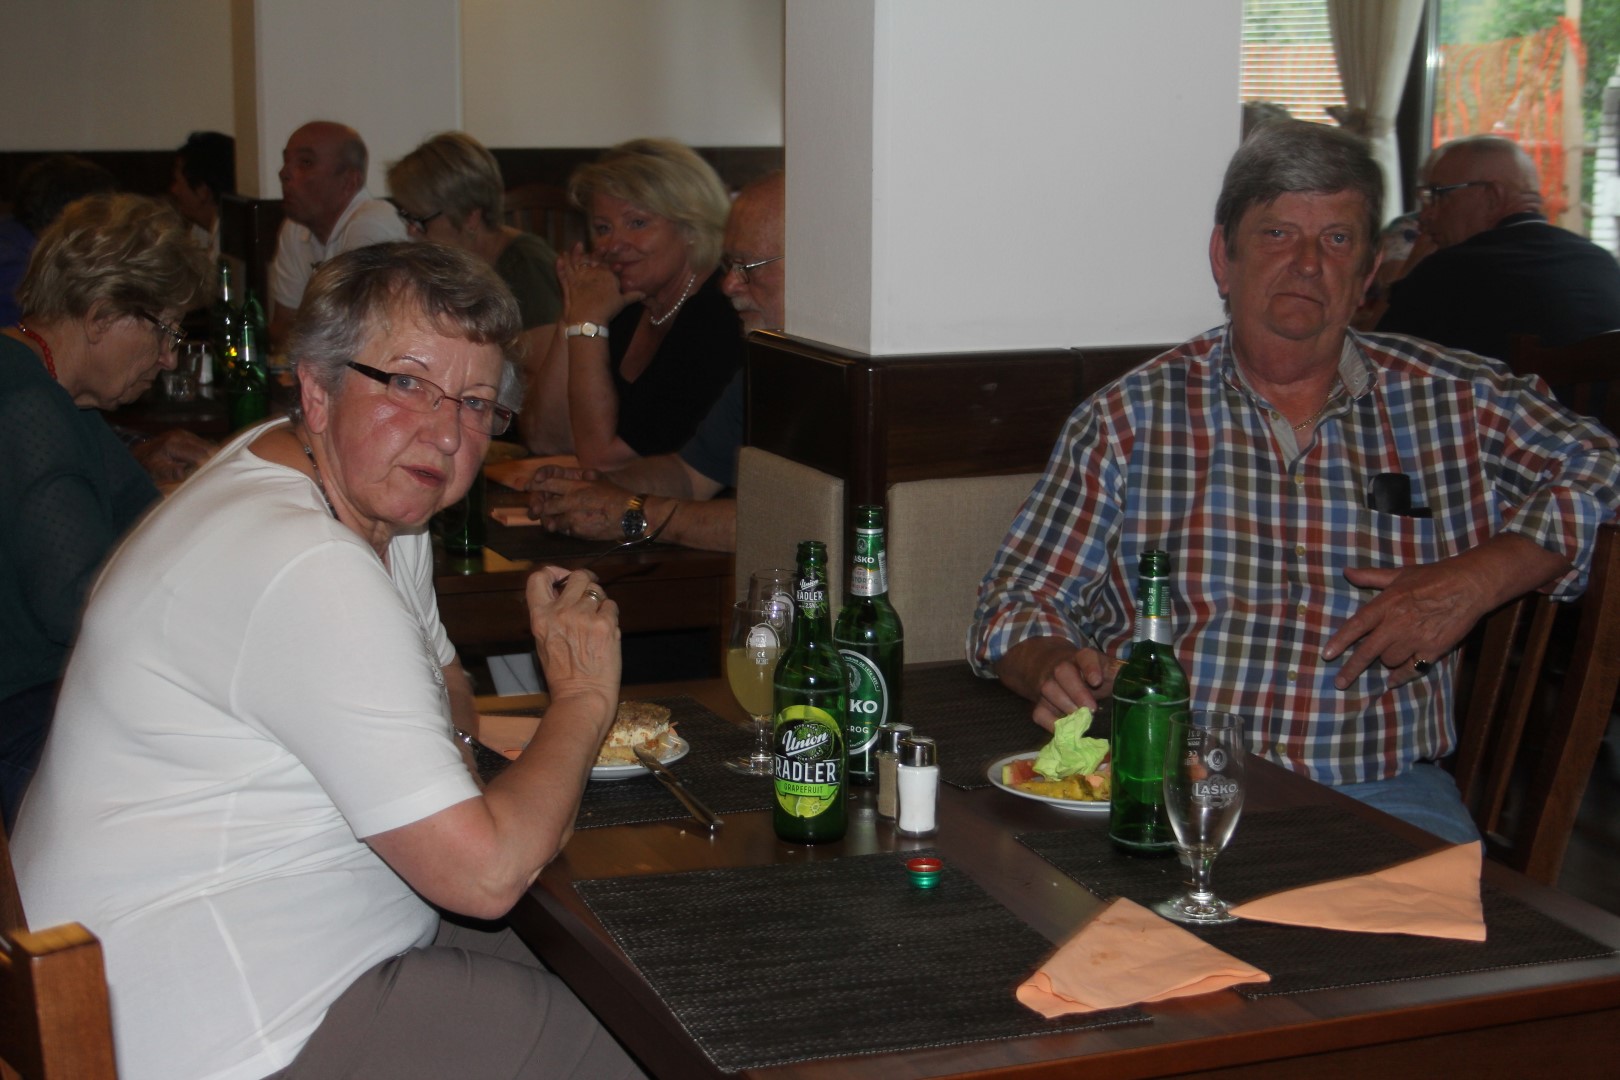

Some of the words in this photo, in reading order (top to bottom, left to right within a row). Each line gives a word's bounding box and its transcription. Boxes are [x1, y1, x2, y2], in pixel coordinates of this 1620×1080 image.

[797, 590, 823, 601] RADLER
[849, 698, 878, 714] KO
[850, 725, 869, 734] ROG
[782, 730, 829, 752] Union
[775, 757, 836, 782] RADLER
[784, 782, 824, 794] GRAPEFRUIT
[1195, 782, 1237, 797] LAŠKO
